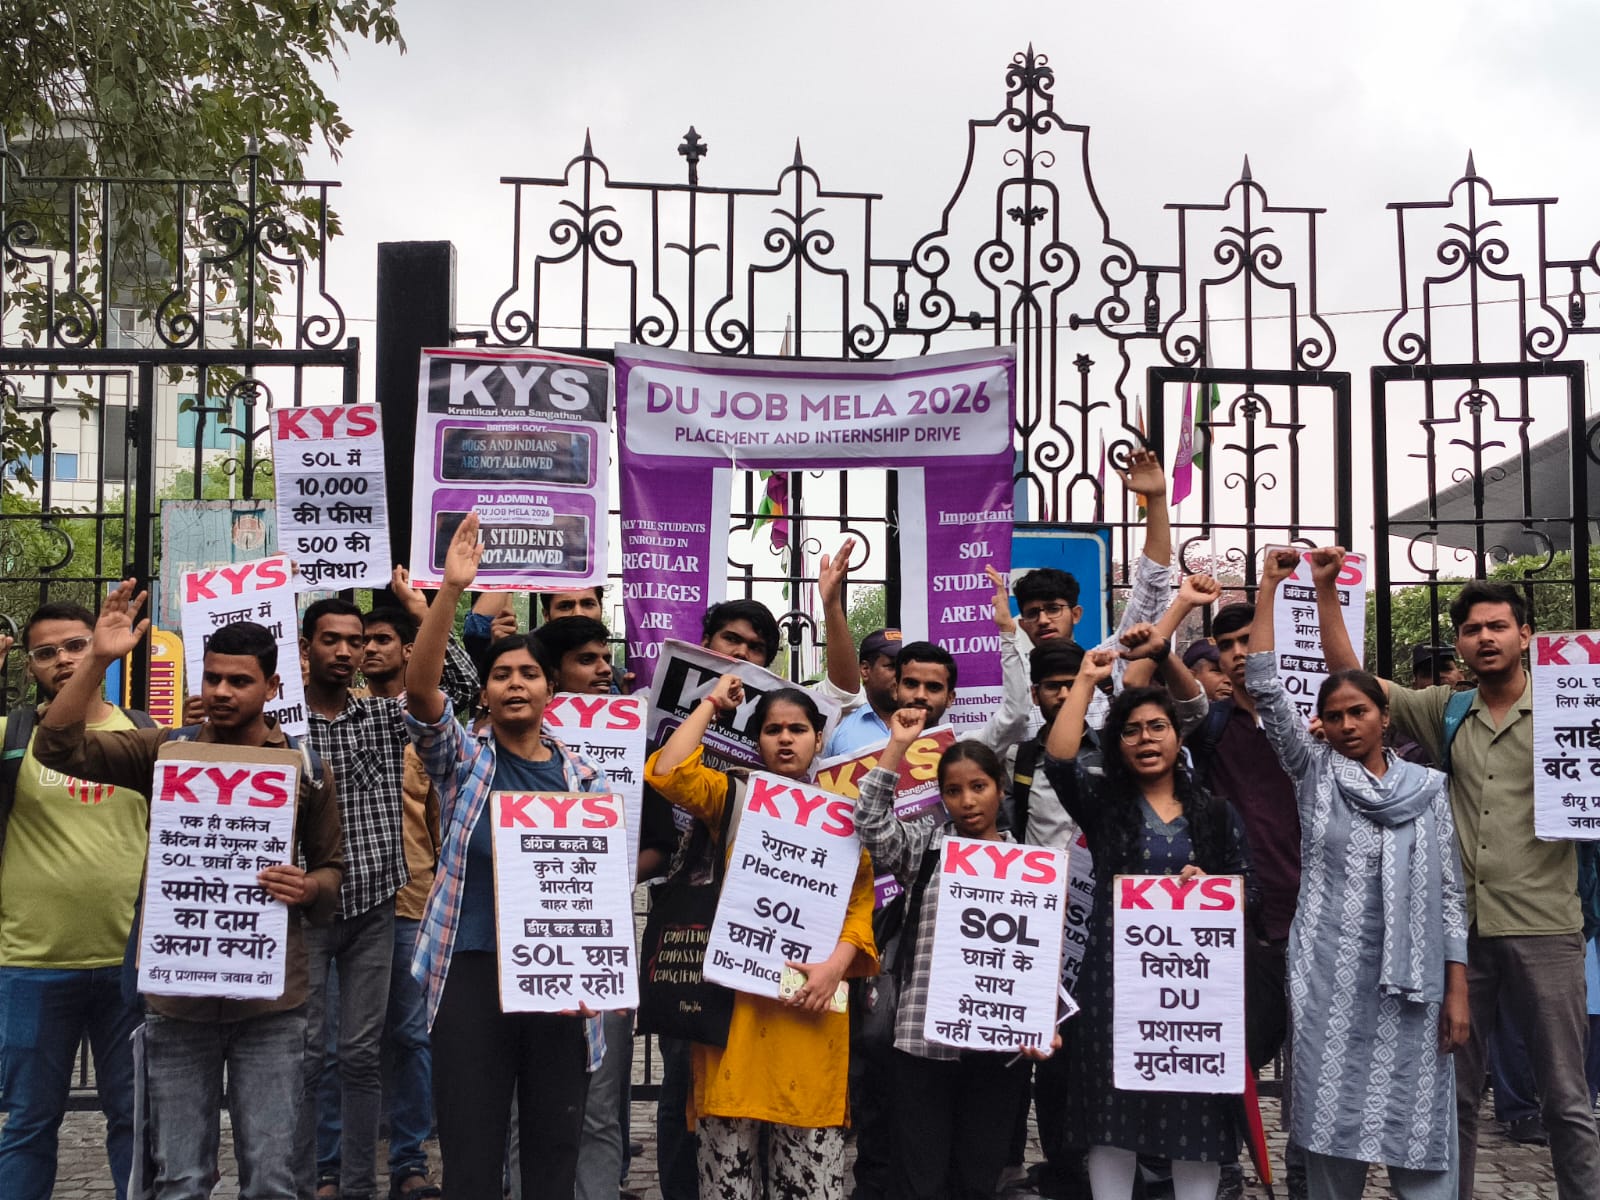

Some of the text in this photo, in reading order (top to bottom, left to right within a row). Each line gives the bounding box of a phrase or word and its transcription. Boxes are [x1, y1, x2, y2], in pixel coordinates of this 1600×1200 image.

[449, 363, 590, 411] KYS
[645, 380, 991, 422] DU JOB MELA 2026
[277, 405, 377, 440] KYS
[448, 407, 582, 421] Krantikari Yuva Sangathan
[490, 440, 512, 451] AND
[514, 440, 557, 452] INDIANS
[675, 426, 961, 446] PLACEMENT AND INTERNSHIP DRIVE
[302, 449, 362, 467] SOL में
[480, 457, 501, 469] NOT
[502, 456, 553, 470] ALLOWED
[295, 477, 368, 498] 10,000
[477, 494, 548, 504] DU ADMIN IN
[292, 502, 373, 525] की फीस
[489, 508, 506, 516] JOB
[508, 508, 529, 516] MELA
[532, 509, 550, 517] 2026
[636, 520, 657, 531] THE
[657, 522, 706, 533] STUDENTS
[297, 532, 371, 553] 500 की
[490, 529, 564, 547] STUDENTS
[629, 535, 689, 548] ENROLLED IN
[503, 549, 563, 564] ALLOWED
[959, 541, 993, 560] SOL
[300, 559, 367, 585] सुविधा?
[622, 552, 700, 573] REGULAR
[186, 559, 287, 603] KYS
[258, 601, 272, 618] में
[940, 605, 977, 624] ARE
[640, 612, 673, 630] ARE
[1278, 675, 1315, 696] OL
[1556, 677, 1587, 689] SOL
[1556, 694, 1579, 708] लिए
[948, 712, 988, 724] British
[719, 726, 739, 741] Yuva
[584, 741, 627, 764] रेगुलर
[1542, 751, 1582, 782] बंद
[160, 765, 288, 808] KYS
[500, 794, 618, 828] KYS
[747, 777, 856, 838] KYS
[898, 804, 922, 817] GOVT.
[1560, 792, 1589, 812] डीयू
[179, 814, 271, 833] एक ही कॉलेज
[204, 834, 217, 849] में
[263, 836, 287, 854] और
[559, 837, 589, 851] कहते
[761, 830, 828, 869] रेगुलर में
[161, 853, 195, 867] SOL
[236, 854, 253, 870] के
[533, 856, 597, 879] कुत्ते और
[943, 841, 1057, 885] KYS
[539, 876, 594, 894] भारतीय
[741, 854, 839, 898] Placement
[161, 876, 229, 903] समोसे
[949, 882, 1058, 911] रोजगार मेले में
[1120, 877, 1236, 911] KYS
[540, 898, 568, 912] बाहर
[753, 897, 806, 930] SOL
[173, 908, 260, 933] का दाम
[526, 920, 553, 937] डीयू
[554, 923, 574, 935] कह
[578, 923, 597, 935] रहा
[960, 907, 1040, 948] SOL
[150, 933, 277, 960] अलग क्यों?
[727, 921, 778, 954] छात्रों
[780, 937, 812, 964] का
[1124, 924, 1236, 948] SOL छात्र
[511, 943, 629, 967] SOL छात्र
[712, 949, 781, 983] Dis-Place
[961, 947, 1034, 972] छात्रों के
[1140, 951, 1210, 979] विरोधी
[149, 965, 171, 984] डीयू
[175, 970, 217, 982] प्रशासन
[516, 968, 625, 1000] बाहर रहो!
[974, 974, 1015, 996] साथ
[958, 994, 1027, 1023] भेदभाव
[1160, 987, 1200, 1010] DU
[935, 1018, 1043, 1049] नहीं चलेगा!
[1138, 1020, 1222, 1043] प्रशासन
[1133, 1045, 1225, 1081] मुर्दाबाद!
